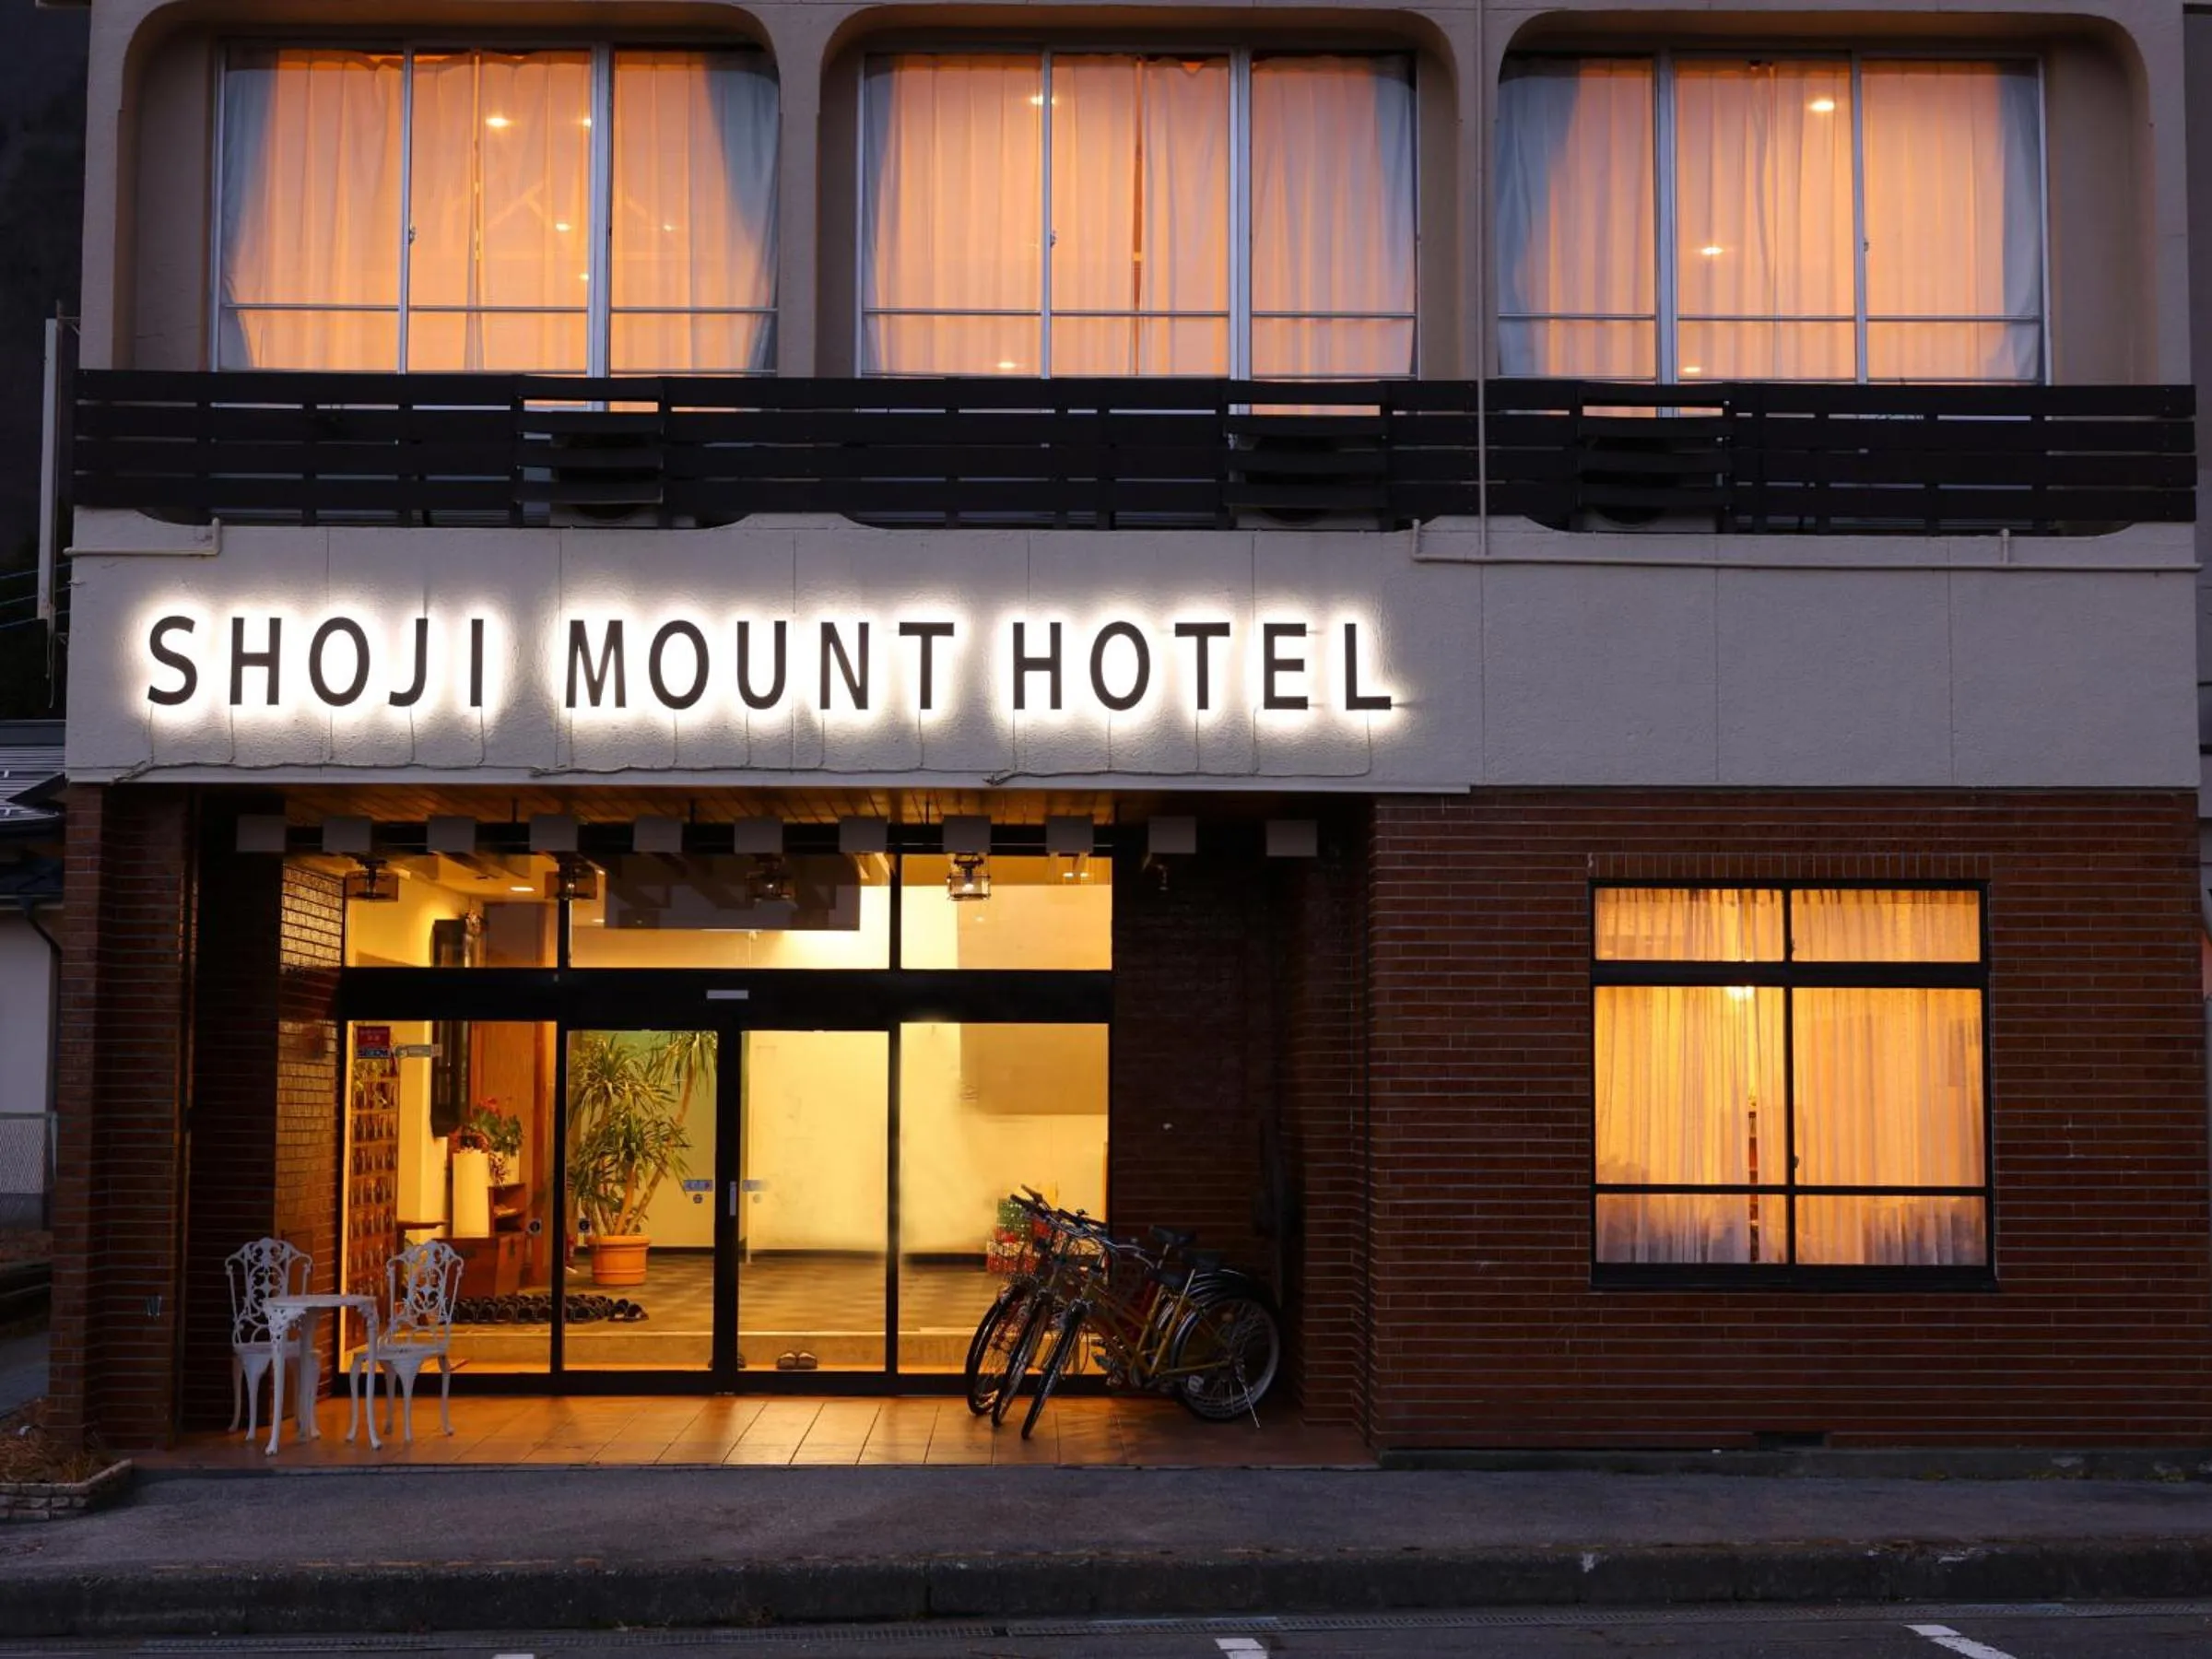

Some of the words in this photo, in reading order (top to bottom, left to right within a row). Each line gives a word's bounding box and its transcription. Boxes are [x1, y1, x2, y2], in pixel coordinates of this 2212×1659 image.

[147, 615, 485, 707] SHOJI
[565, 618, 955, 711] MOUNT
[1013, 620, 1392, 711] HOTEL
